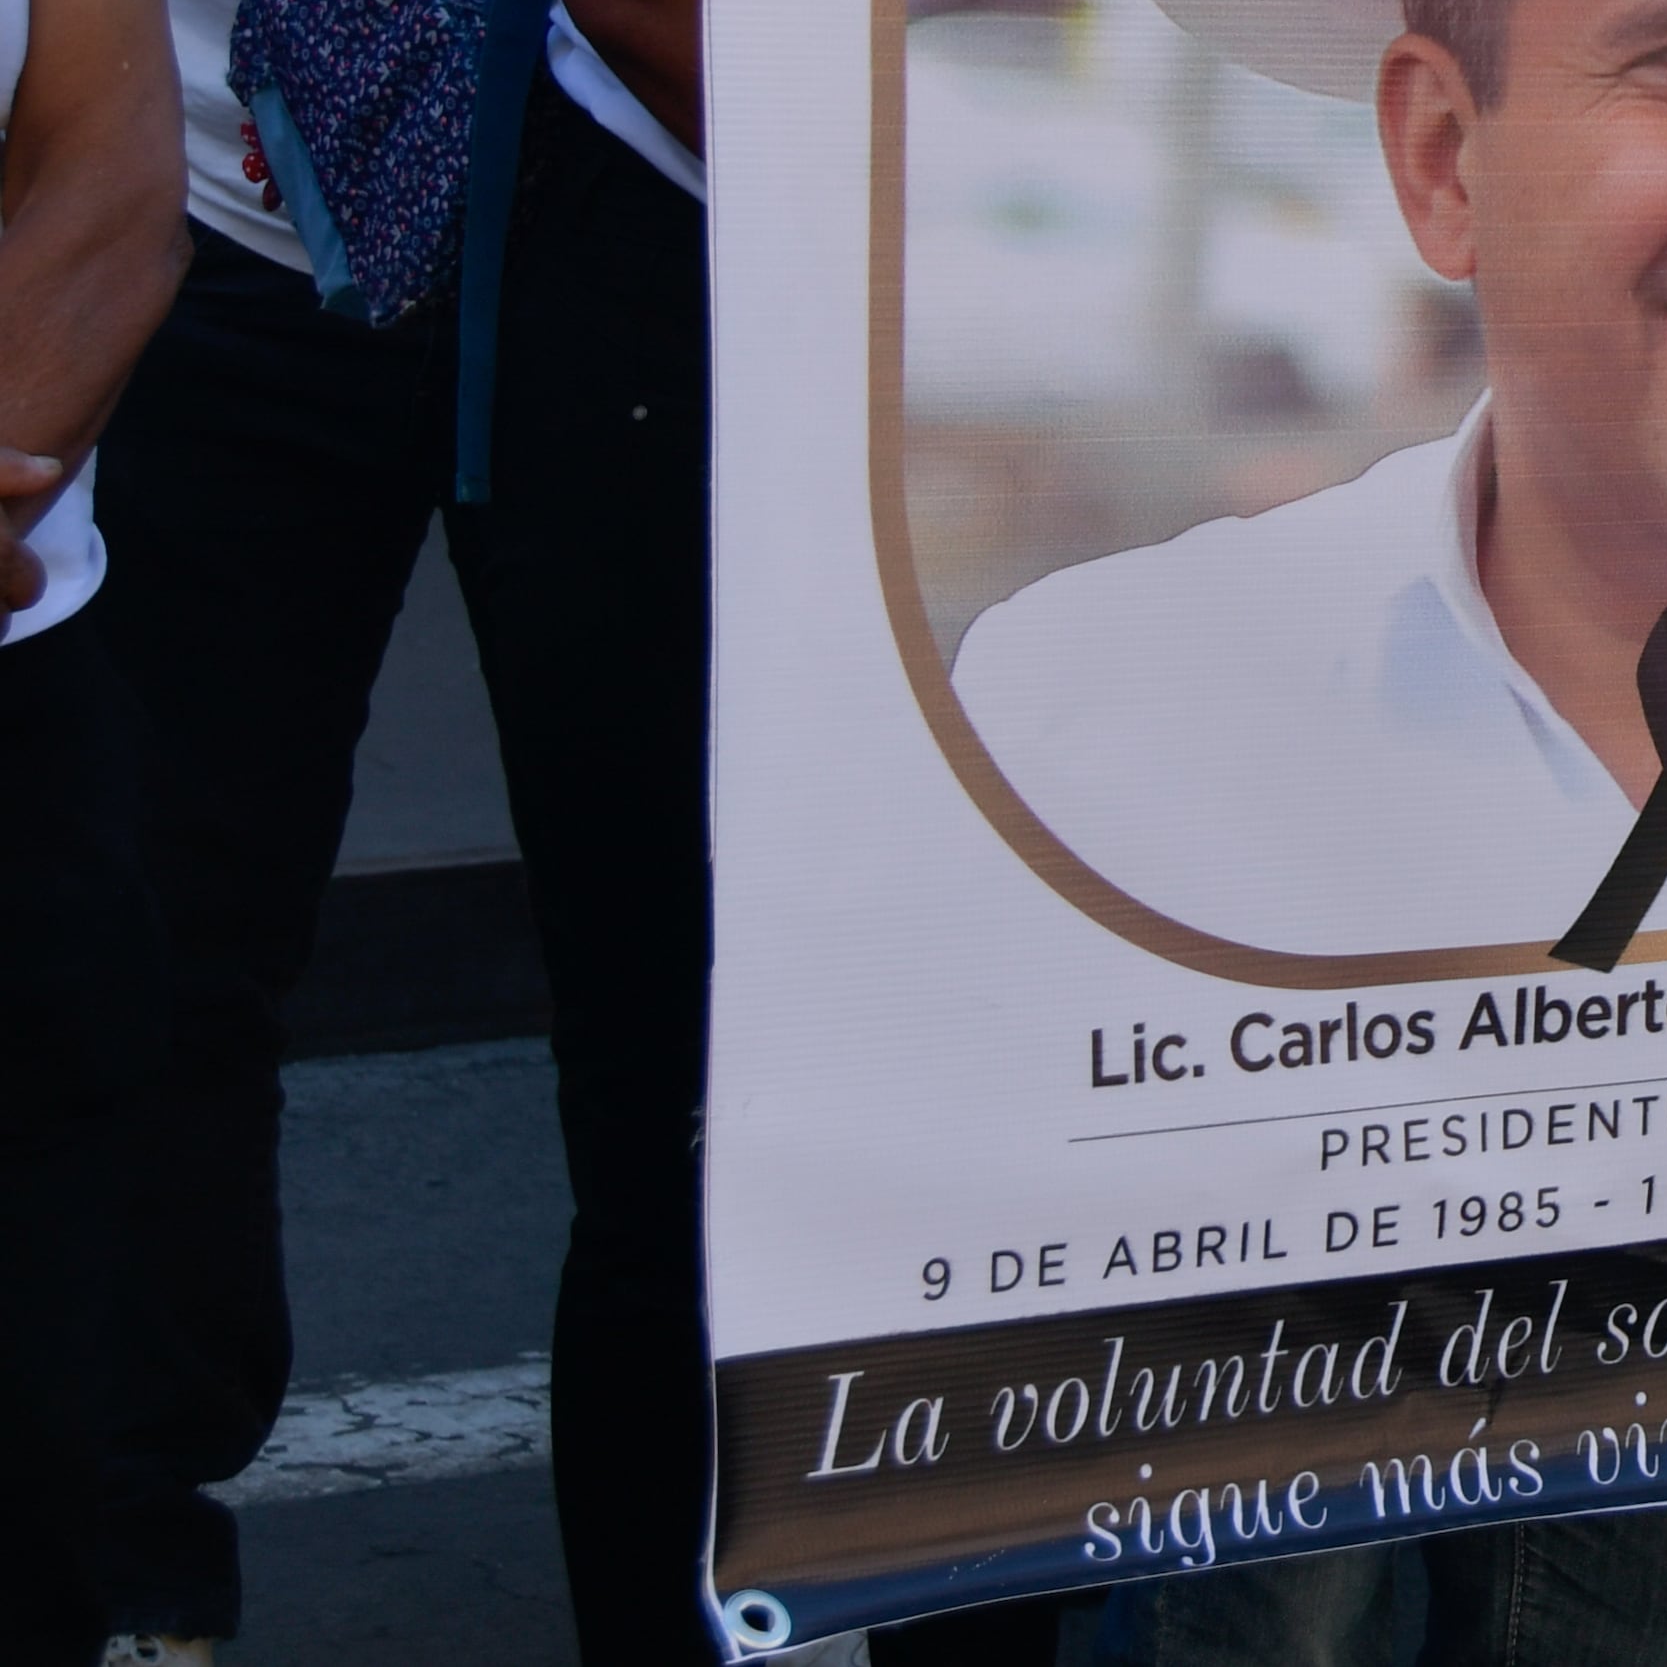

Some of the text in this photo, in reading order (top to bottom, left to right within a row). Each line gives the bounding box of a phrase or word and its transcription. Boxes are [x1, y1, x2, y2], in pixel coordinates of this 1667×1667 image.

[1091, 1022, 1205, 1089] Lic.
[1230, 1003, 1436, 1073] Carlos
[922, 1257, 952, 1301] 9
[991, 1243, 1068, 1293] DE
[1103, 1219, 1288, 1279] ABRIL
[1326, 1204, 1400, 1253] DE
[1433, 1186, 1560, 1239] 1985
[1642, 1175, 1655, 1214] 1
[806, 1371, 950, 1480] La
[990, 1300, 1406, 1451] voluntad
[1440, 1279, 1568, 1387] del
[1083, 1463, 1328, 1568] sigue
[1360, 1417, 1543, 1519] más
